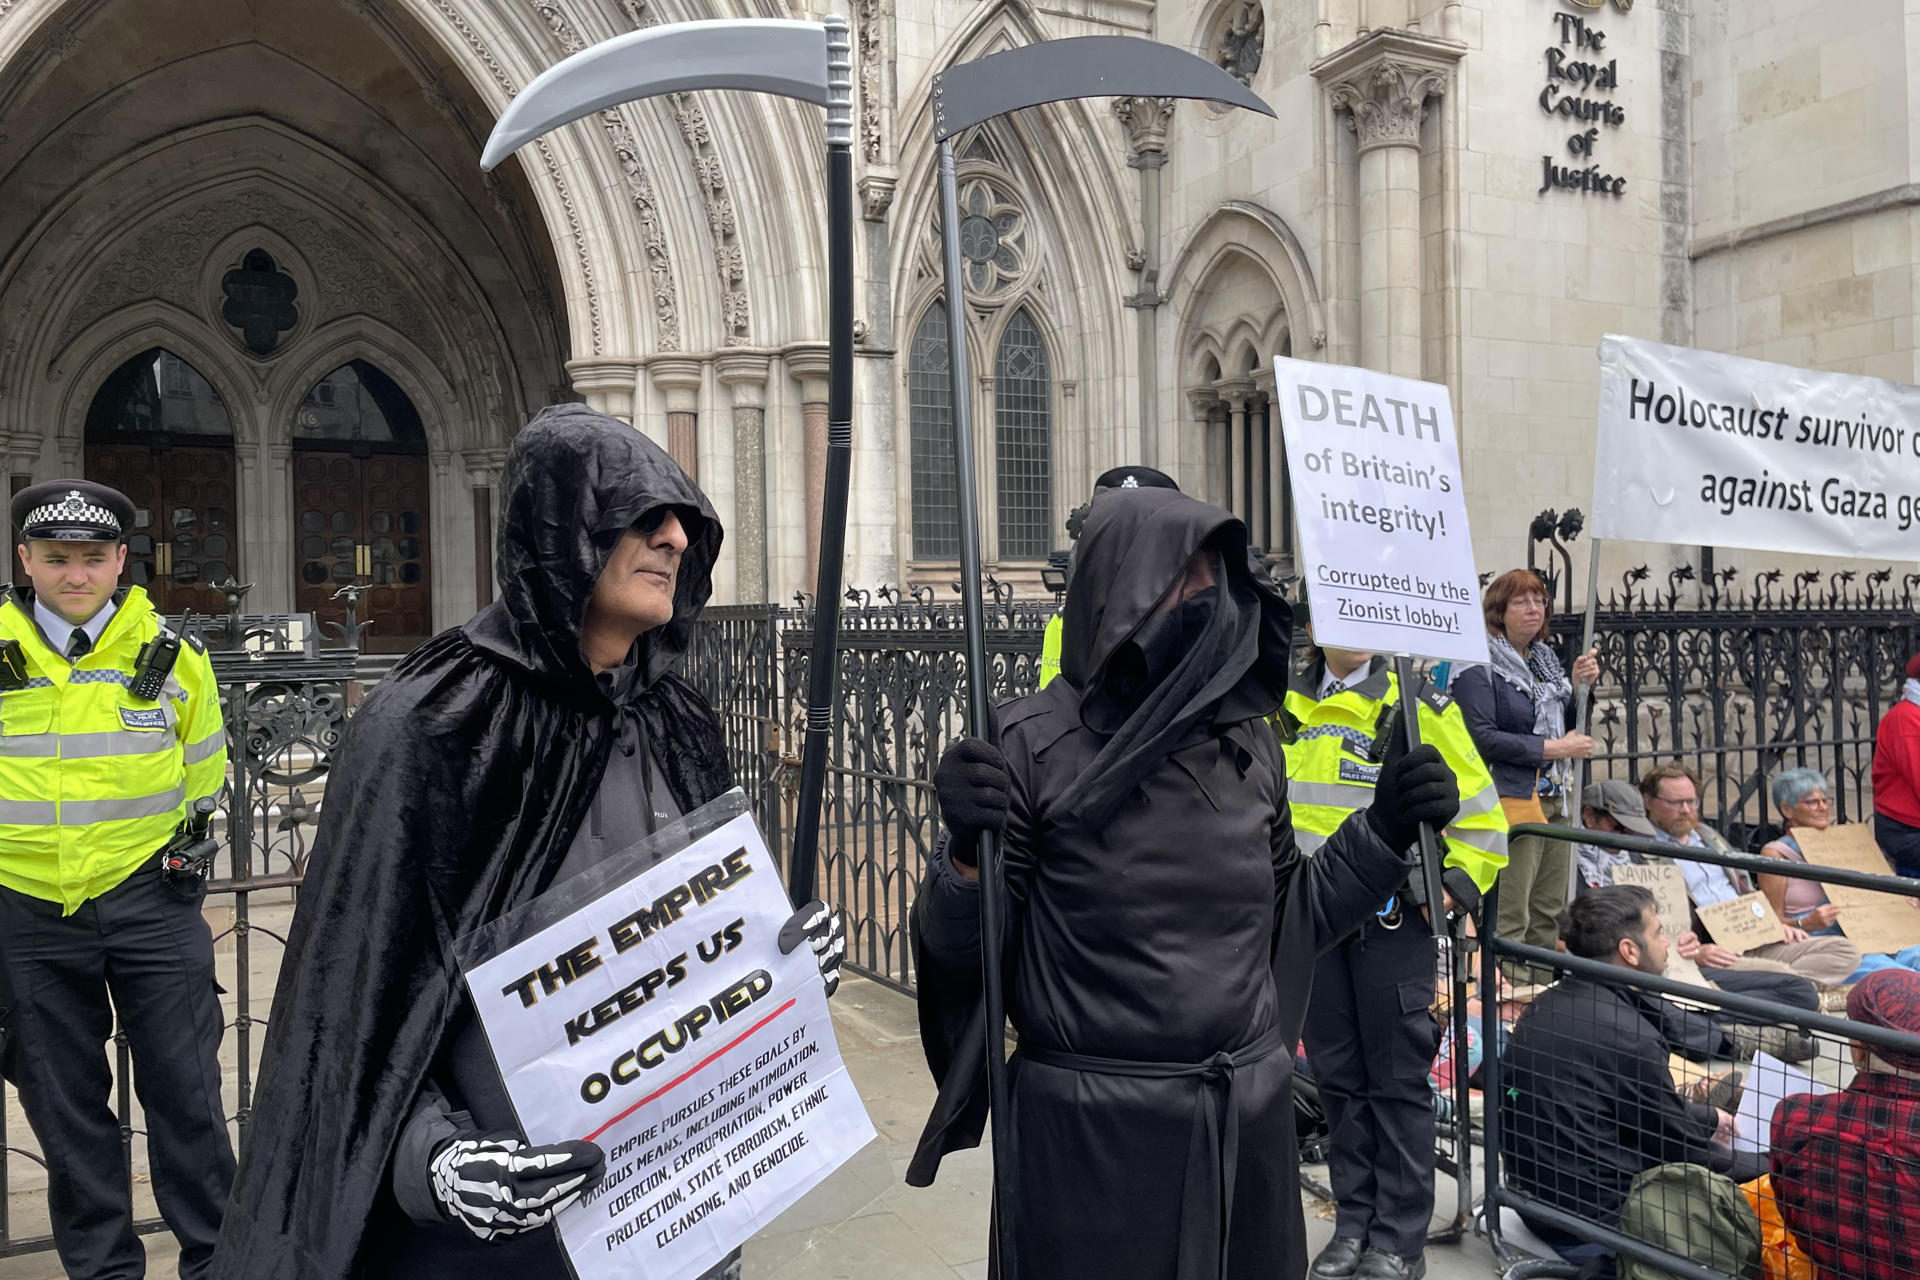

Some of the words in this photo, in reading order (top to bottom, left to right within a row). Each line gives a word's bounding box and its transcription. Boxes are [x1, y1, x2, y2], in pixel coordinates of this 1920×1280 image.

[1554, 12, 1606, 50] The
[1545, 47, 1618, 92] Royal
[1540, 83, 1624, 125] Courts
[1567, 127, 1599, 157] of
[1538, 156, 1627, 197] Justice
[1297, 384, 1440, 443] DEATH
[1629, 378, 1788, 441] Holocaust
[1795, 413, 1904, 454] survivor
[1304, 448, 1332, 474] of
[1341, 451, 1450, 493] Britain's
[1321, 493, 1446, 540] integrity!
[1700, 470, 1813, 515] against
[1821, 477, 1887, 520] Gaza
[1317, 564, 1411, 592] Corrupted
[1417, 576, 1436, 599] by
[1441, 581, 1470, 601] the
[1337, 598, 1401, 622] Zionist
[1405, 605, 1460, 632] lobby!
[1341, 772, 1360, 780] POLICE
[1619, 866, 1672, 883] SAVING
[501, 935, 603, 1009] THE
[607, 845, 754, 955] EMPIRE
[564, 952, 688, 1047] KEEPS
[696, 917, 746, 964] US
[580, 968, 773, 1104] OCCUPIED
[610, 1125, 658, 1162] EMPIRE
[661, 1088, 715, 1133] PURSUES
[718, 1063, 752, 1095] THESE
[755, 1039, 790, 1070] GOALS
[792, 1024, 807, 1044] BY
[637, 1134, 682, 1171] MEANS,
[686, 1092, 746, 1140] INCLUDING
[748, 1041, 819, 1099] INTIMIDATION,
[606, 1188, 686, 1251] PROJECTION,
[687, 1159, 723, 1195] STATE
[724, 1114, 791, 1168] TERRORISM,
[791, 1085, 829, 1121] ETHNIC
[608, 1165, 672, 1218] COERCION,
[673, 1101, 766, 1174] EXPROPRIATION,
[768, 1071, 808, 1109] POWER
[656, 1192, 726, 1249] CLEANSING,
[727, 1172, 752, 1199] AND
[753, 1131, 809, 1180] GENOCIDE.
